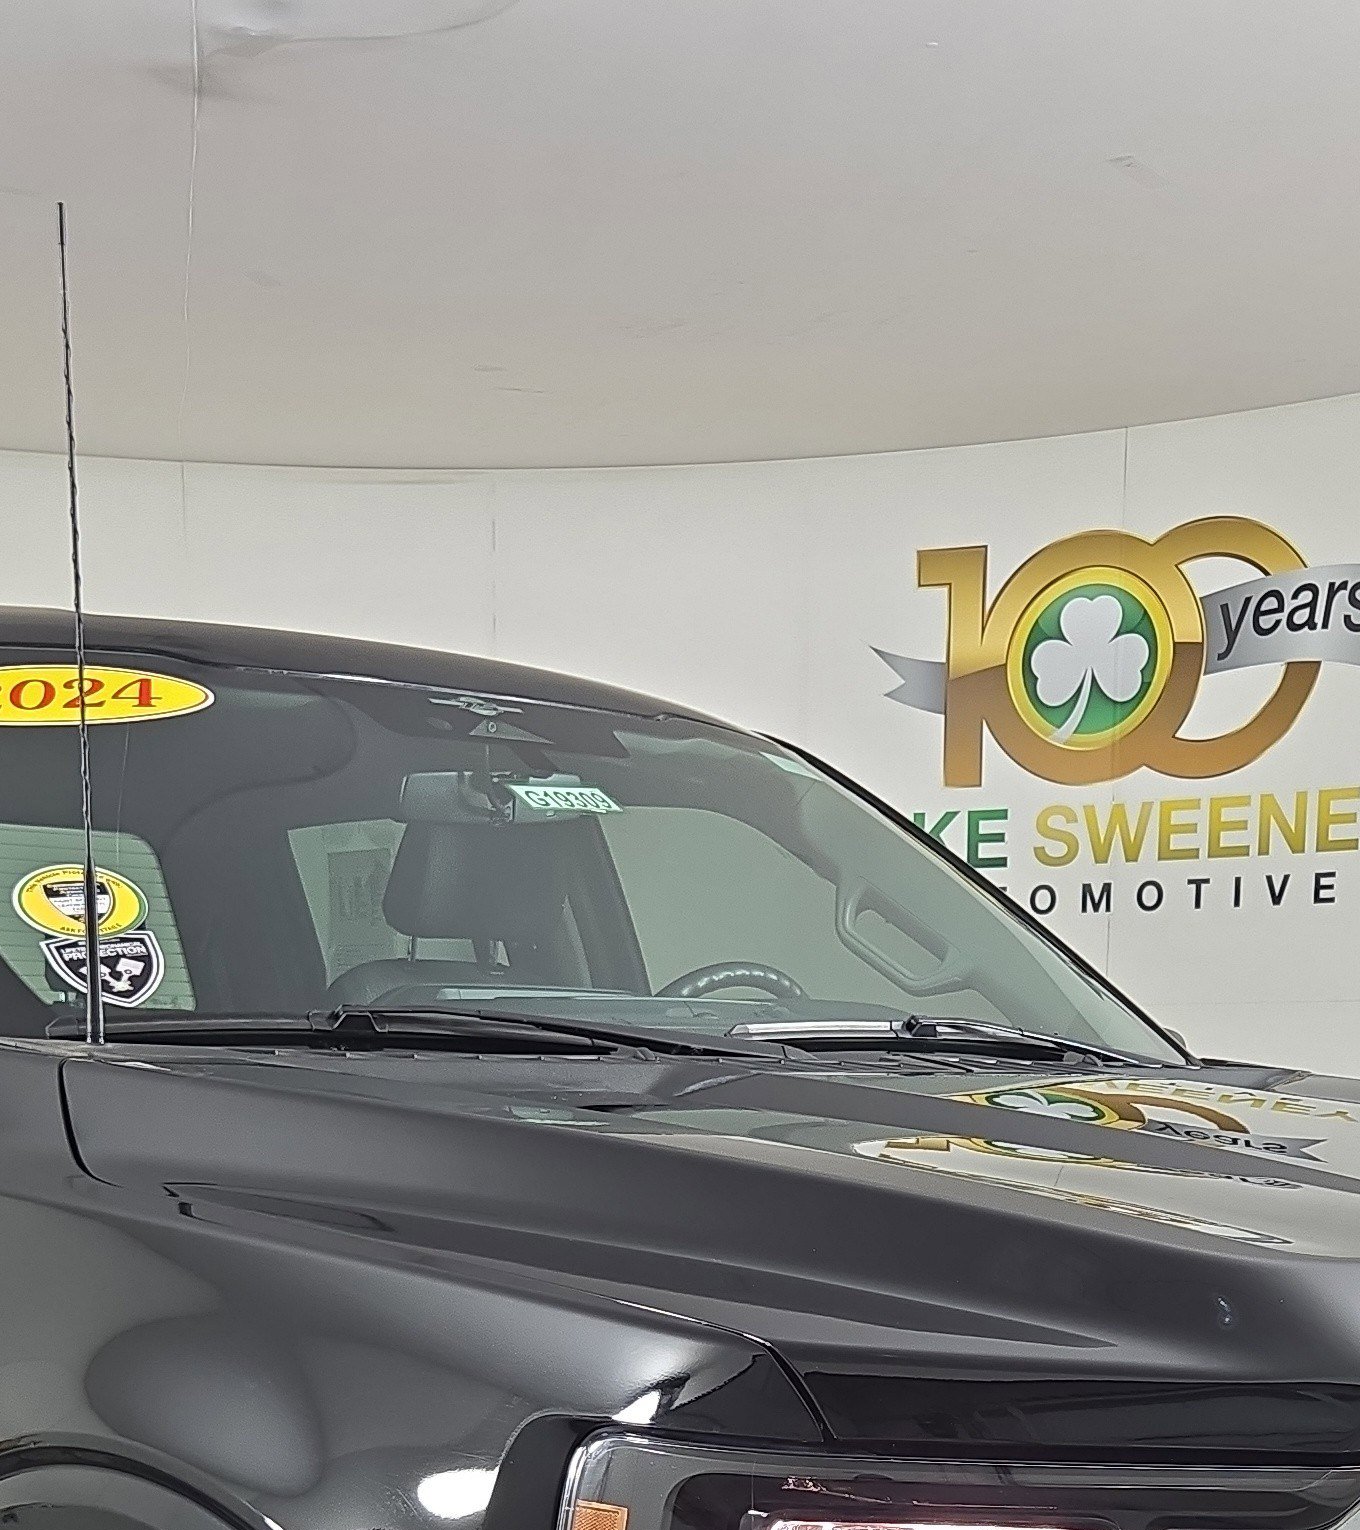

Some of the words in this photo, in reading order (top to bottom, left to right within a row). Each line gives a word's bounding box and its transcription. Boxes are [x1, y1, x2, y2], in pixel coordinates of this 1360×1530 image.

[916, 515, 1322, 789] 100
[524, 790, 613, 808] G19309
[1028, 871, 1338, 916] OMOTIVE
